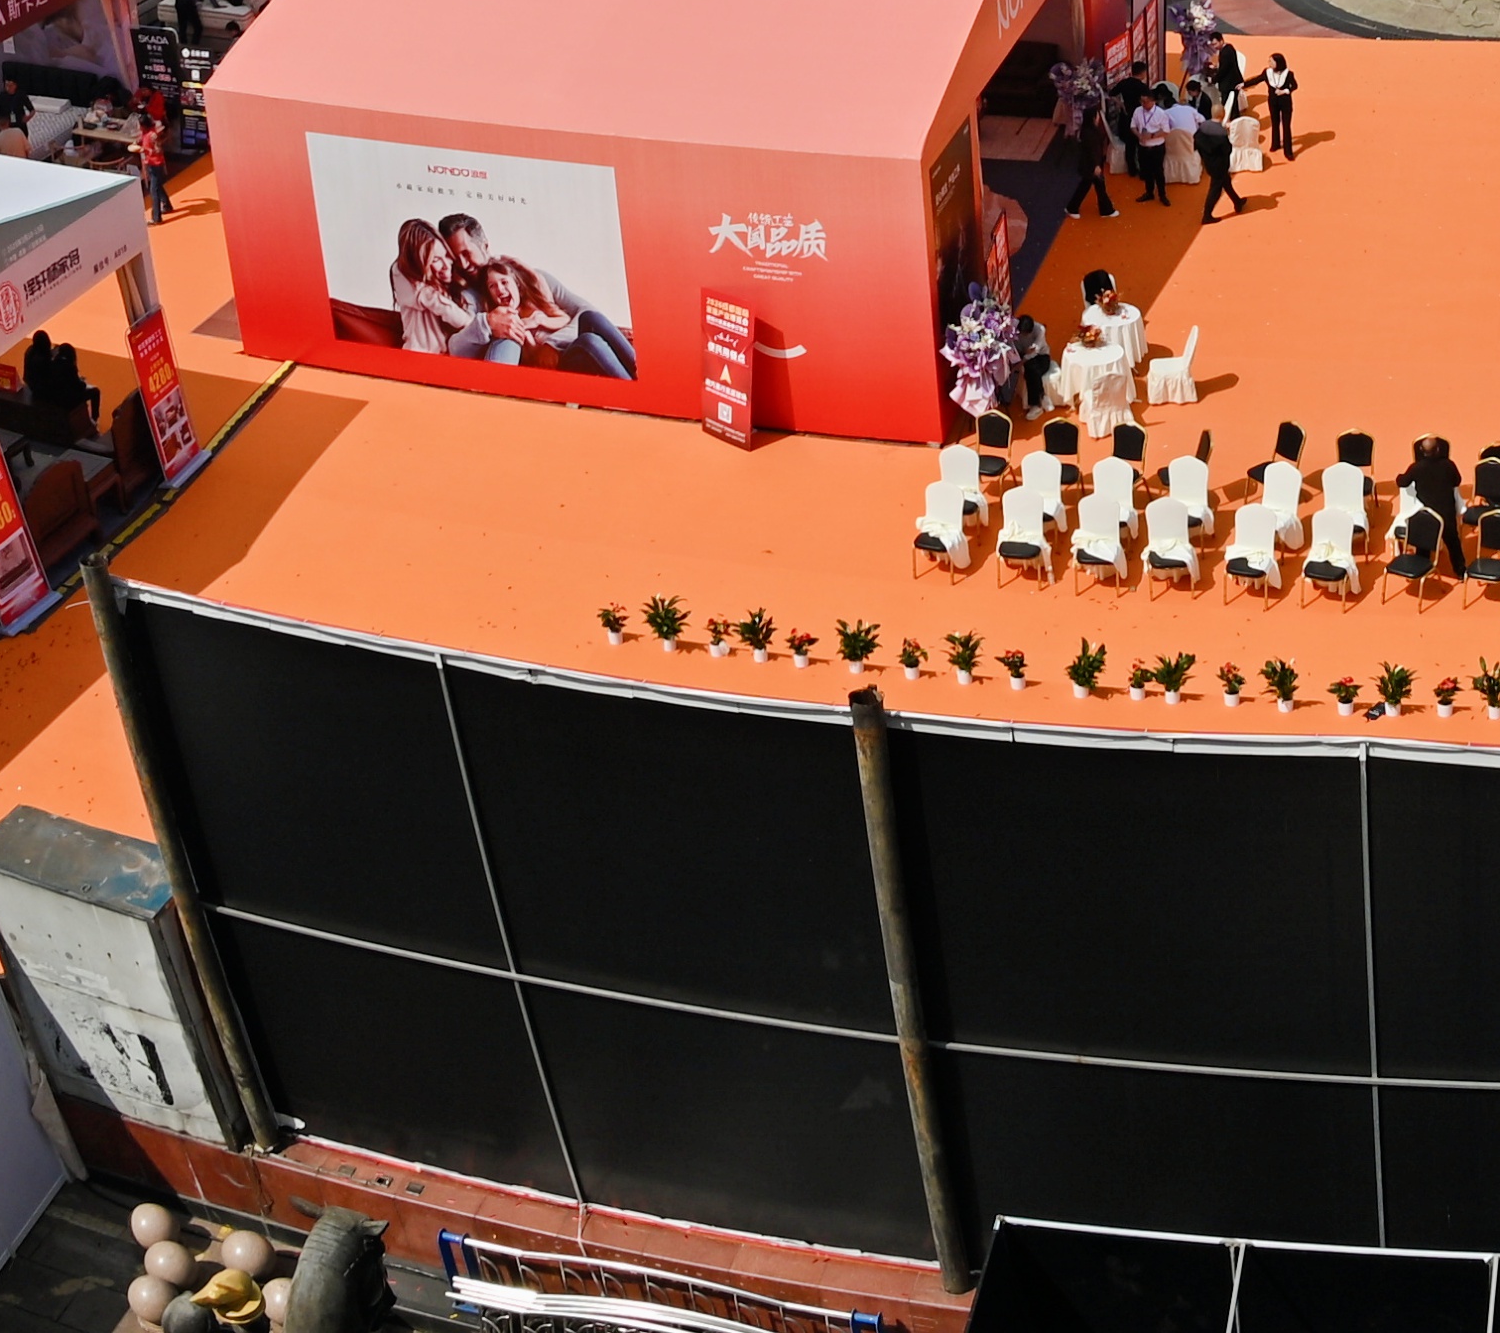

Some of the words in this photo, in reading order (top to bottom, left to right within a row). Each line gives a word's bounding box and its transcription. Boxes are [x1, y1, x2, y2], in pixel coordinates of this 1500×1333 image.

[746, 212, 794, 229] 传统工艺
[707, 212, 829, 262] 大国品质
[148, 362, 172, 394] 4280
